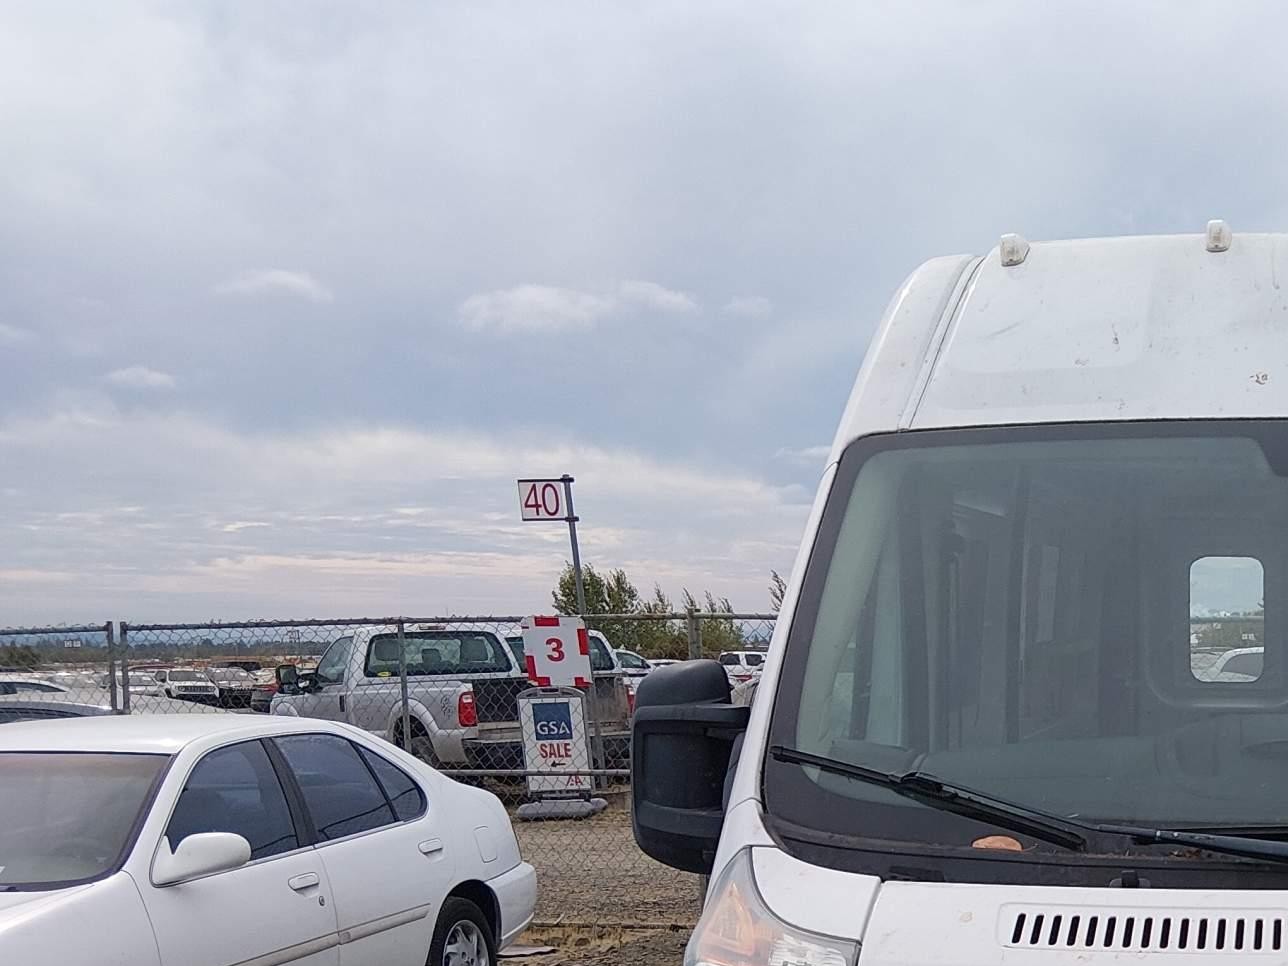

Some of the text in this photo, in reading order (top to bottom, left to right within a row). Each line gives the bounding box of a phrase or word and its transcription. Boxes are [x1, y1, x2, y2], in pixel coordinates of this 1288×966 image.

[524, 483, 560, 516] 40
[545, 638, 564, 661] 3
[537, 721, 570, 735] GSA
[540, 743, 571, 758] SALE
